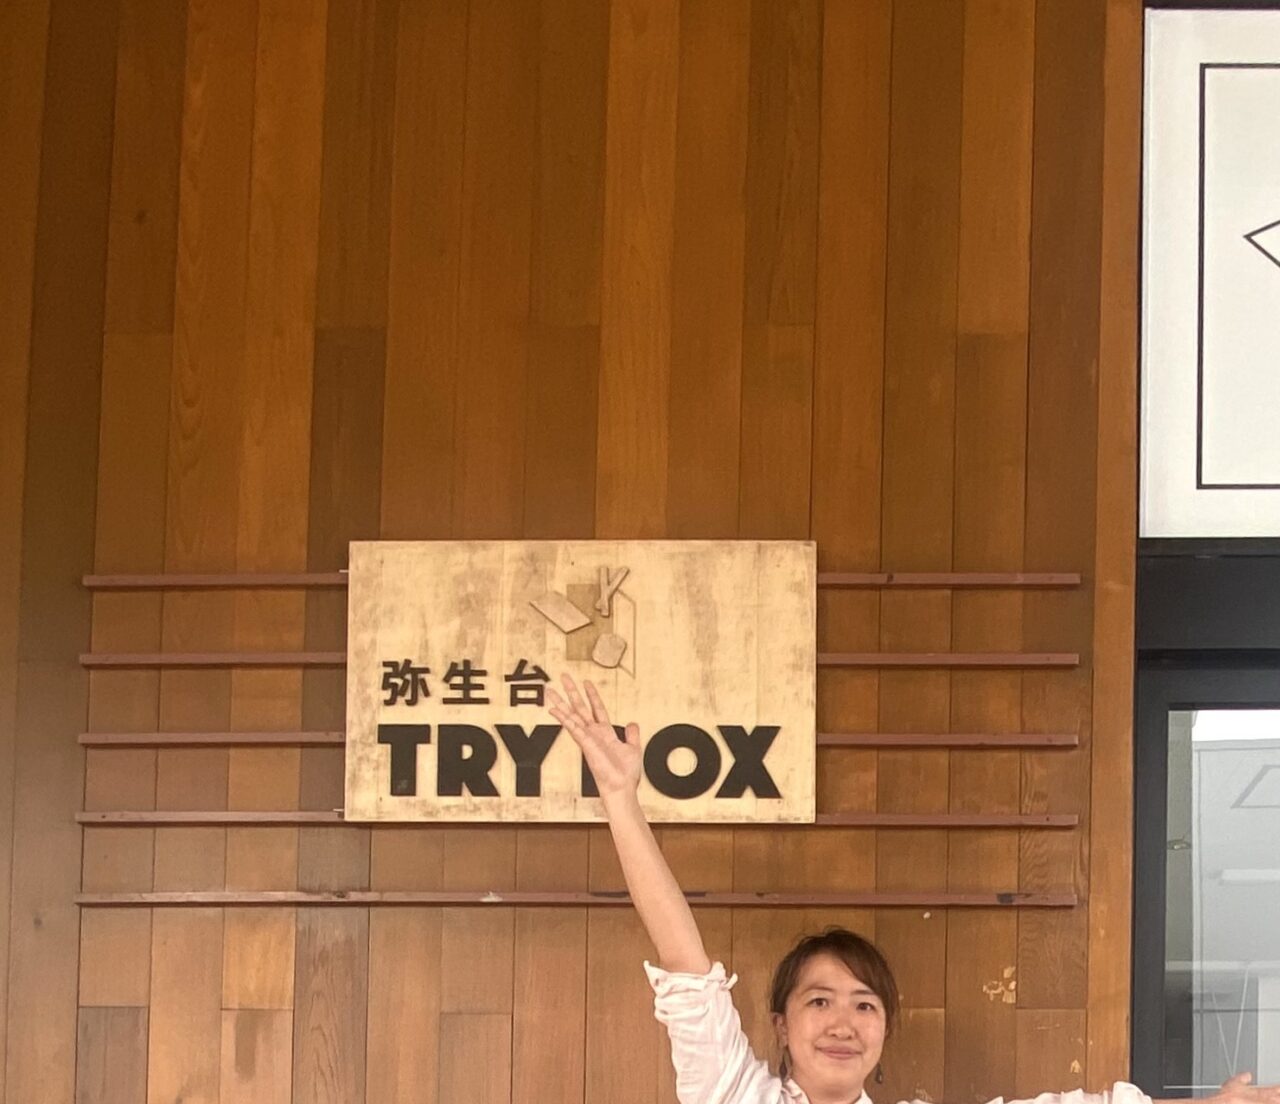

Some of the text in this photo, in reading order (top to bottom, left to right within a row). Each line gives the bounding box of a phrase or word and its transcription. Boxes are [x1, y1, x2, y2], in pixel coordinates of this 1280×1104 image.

[381, 658, 551, 707] 弥生台
[377, 723, 562, 797] TRY
